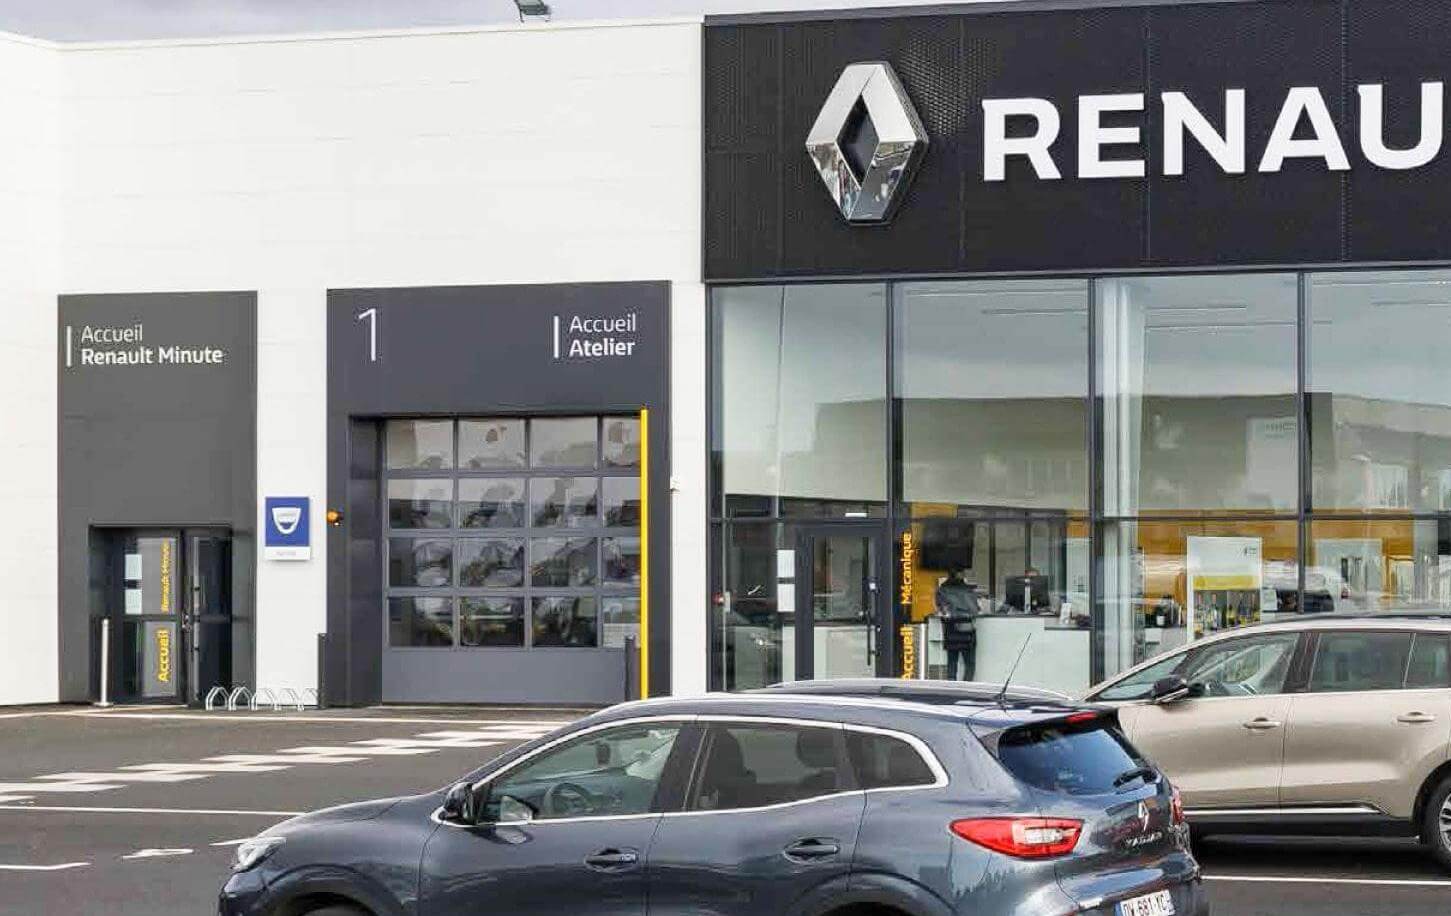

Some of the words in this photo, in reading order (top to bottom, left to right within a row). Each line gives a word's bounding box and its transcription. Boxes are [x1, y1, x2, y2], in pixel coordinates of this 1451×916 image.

[81, 323, 143, 343] Accueil
[358, 308, 377, 362] 1
[568, 313, 637, 333] Accueil
[81, 346, 154, 365] Renault
[158, 346, 223, 364] Minute
[568, 338, 636, 358] Atelier
[901, 533, 914, 604] Mécanique
[157, 629, 170, 682] Accueil
[901, 627, 914, 681] Accueil
